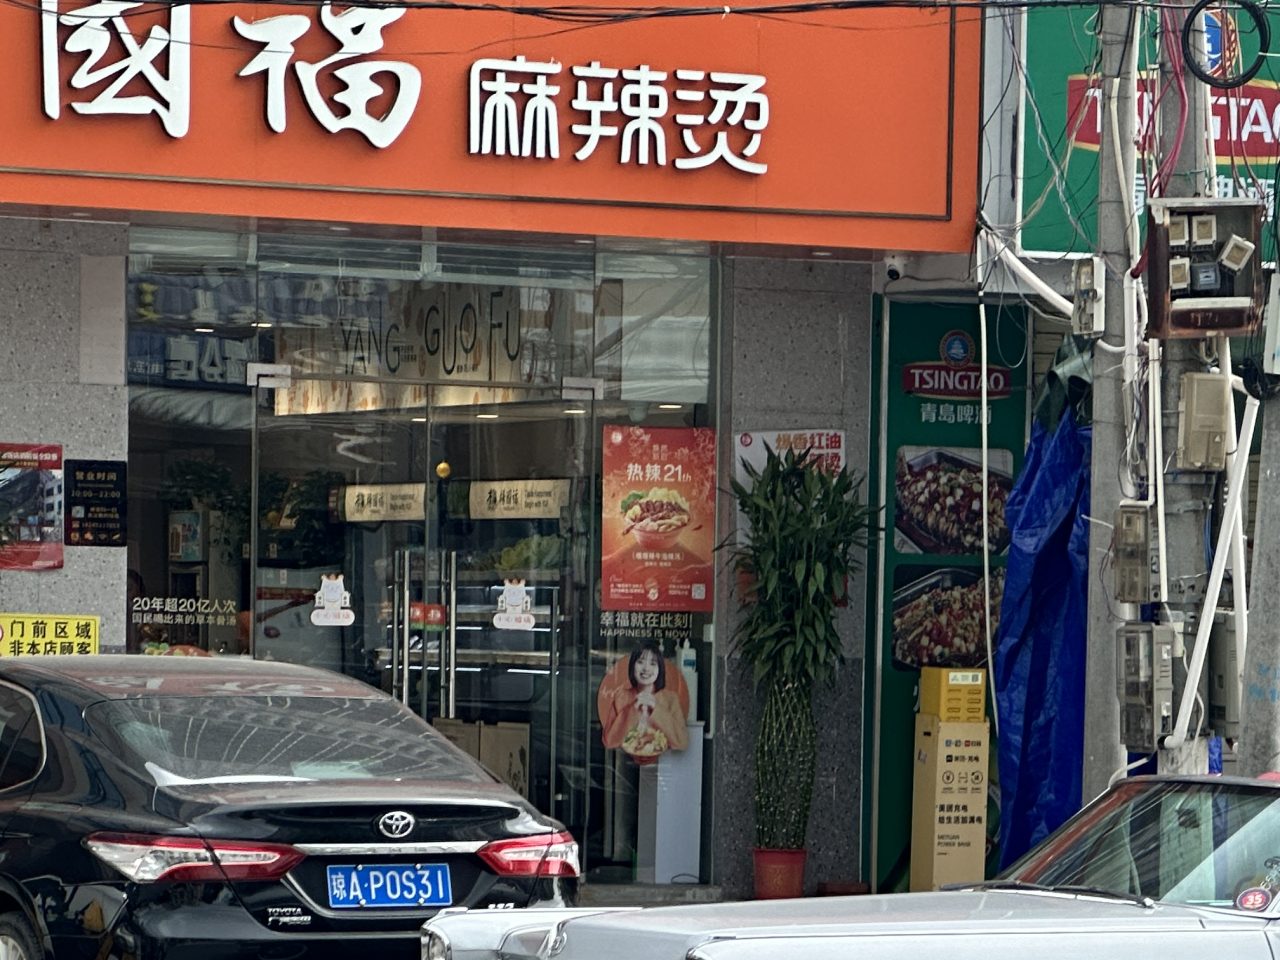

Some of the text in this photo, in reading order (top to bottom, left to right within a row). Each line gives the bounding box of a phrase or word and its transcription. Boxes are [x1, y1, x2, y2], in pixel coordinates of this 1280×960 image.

[469, 55, 770, 174] 麻辣烫
[910, 369, 1004, 391] TSINGTAO
[626, 463, 660, 482] 热辣
[132, 597, 237, 613] 20年超20亿人次
[10, 619, 92, 640] 门前区域
[600, 628, 692, 638] HAPPINESS IS NOW!
[9, 641, 92, 656] 非本店顾客
[1246, 894, 1264, 905] 35
[267, 907, 302, 916] TOYOTA
